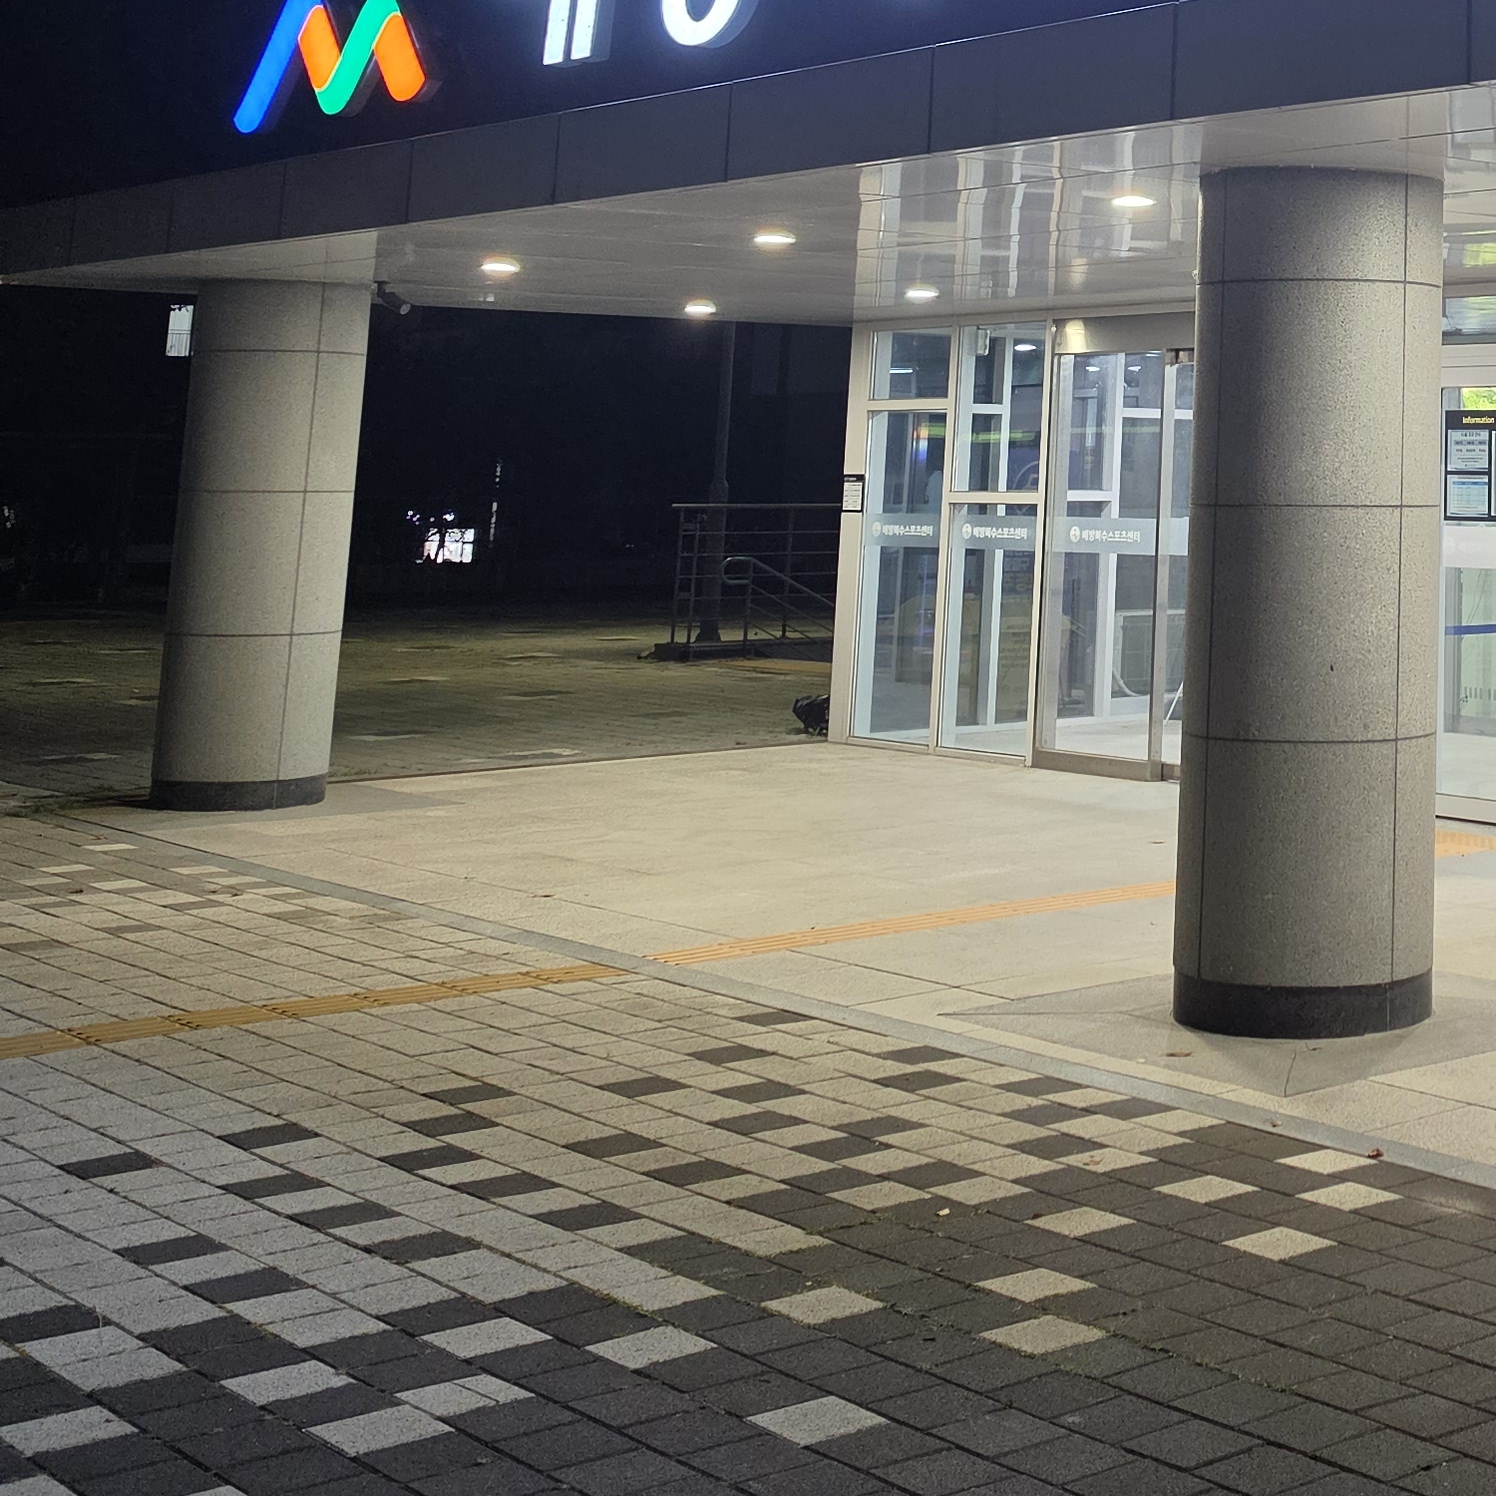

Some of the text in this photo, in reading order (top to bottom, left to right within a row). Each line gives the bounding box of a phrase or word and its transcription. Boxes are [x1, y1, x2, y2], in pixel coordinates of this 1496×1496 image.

[1462, 416, 1495, 424] Information
[973, 526, 1028, 540] 배방북수스포츠센터
[1082, 529, 1141, 543] 배방북수스포츠센터
